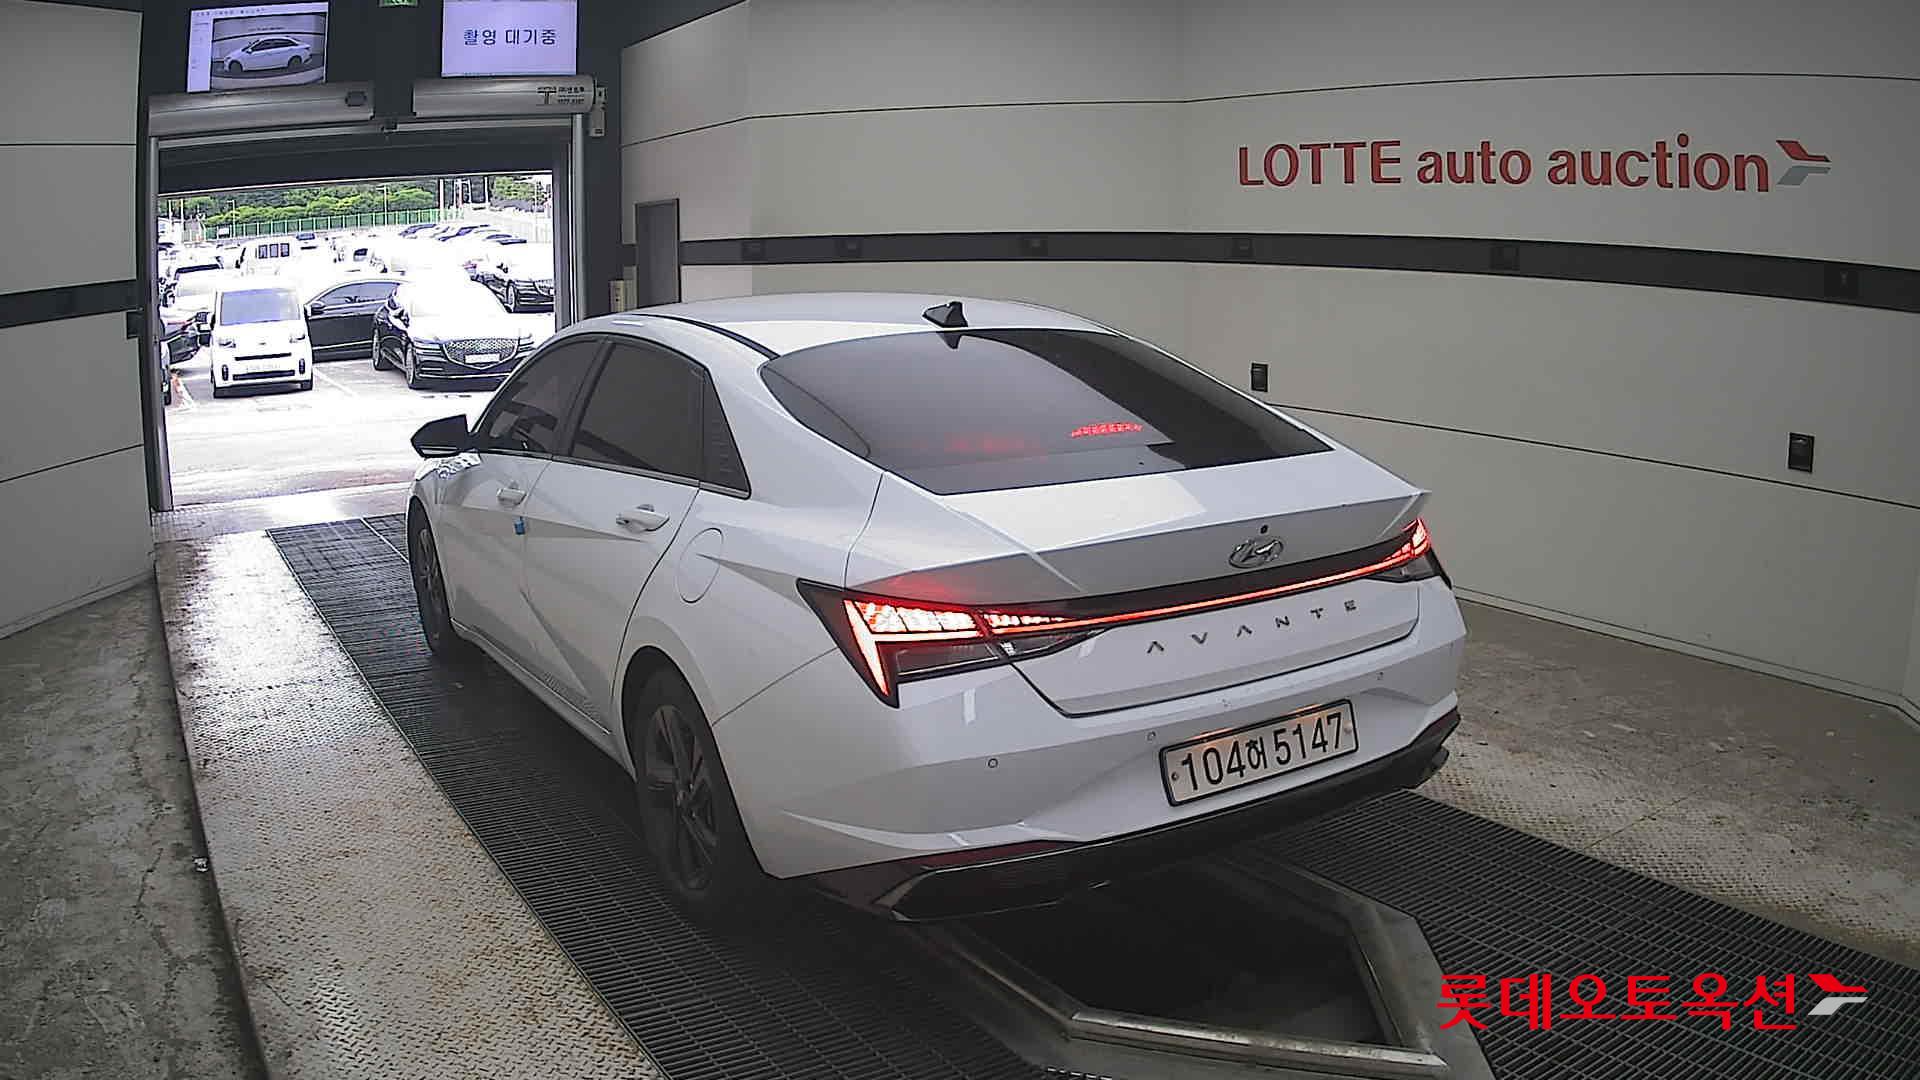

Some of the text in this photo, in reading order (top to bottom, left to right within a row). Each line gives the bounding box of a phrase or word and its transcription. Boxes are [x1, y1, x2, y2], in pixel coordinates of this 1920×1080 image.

[505, 29, 557, 45] 대기중
[1238, 133, 1769, 192] LOTTE auto auction
[1146, 600, 1357, 654] AVANTE
